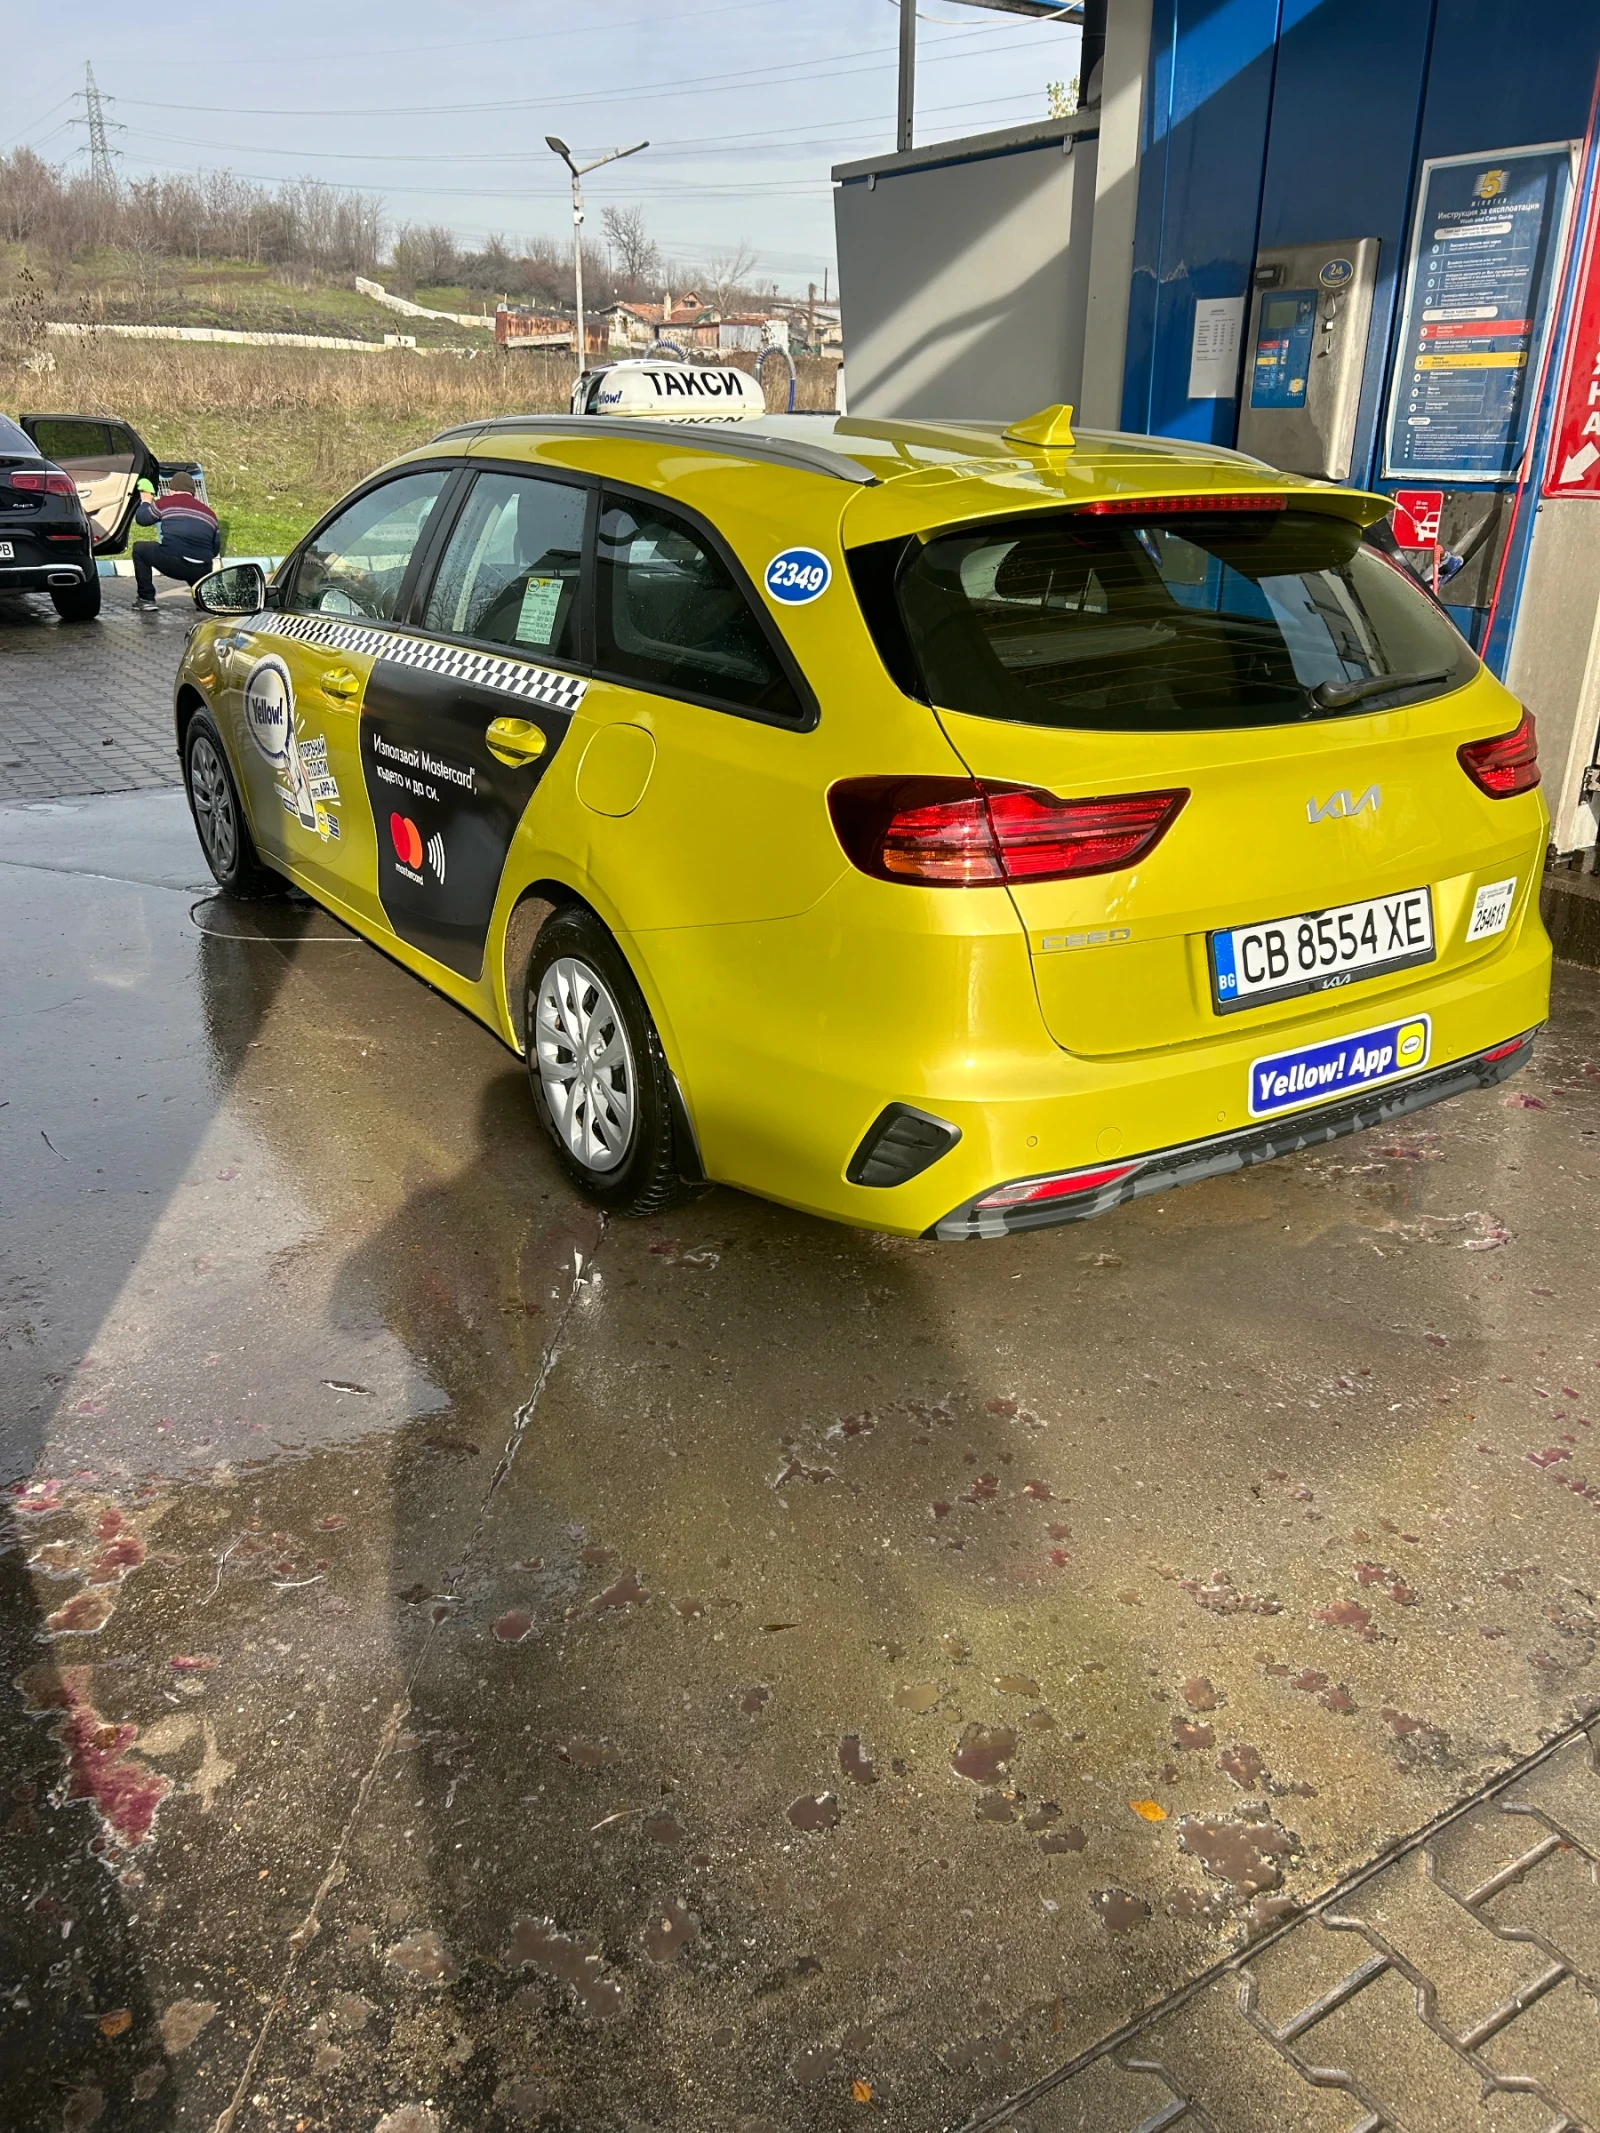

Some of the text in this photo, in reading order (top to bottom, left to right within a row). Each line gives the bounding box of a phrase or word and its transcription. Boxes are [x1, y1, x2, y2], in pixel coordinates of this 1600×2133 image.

[1479, 169, 1503, 199] 5
[1438, 202, 1540, 220] Инструкция за експлоатация
[642, 372, 743, 396] ТАКСИ
[0, 543, 11, 556] B
[769, 560, 824, 592] 2349
[252, 697, 283, 725] Yellow!
[373, 733, 420, 769] Използвай
[376, 765, 440, 802] където и да си.
[1306, 784, 1382, 824] KIA
[1474, 902, 1506, 933] 254613
[1242, 897, 1425, 984] CB 8554 XE
[1218, 974, 1236, 990] BG
[1321, 973, 1352, 989] KIA
[1260, 1045, 1393, 1101] Yellow! App
